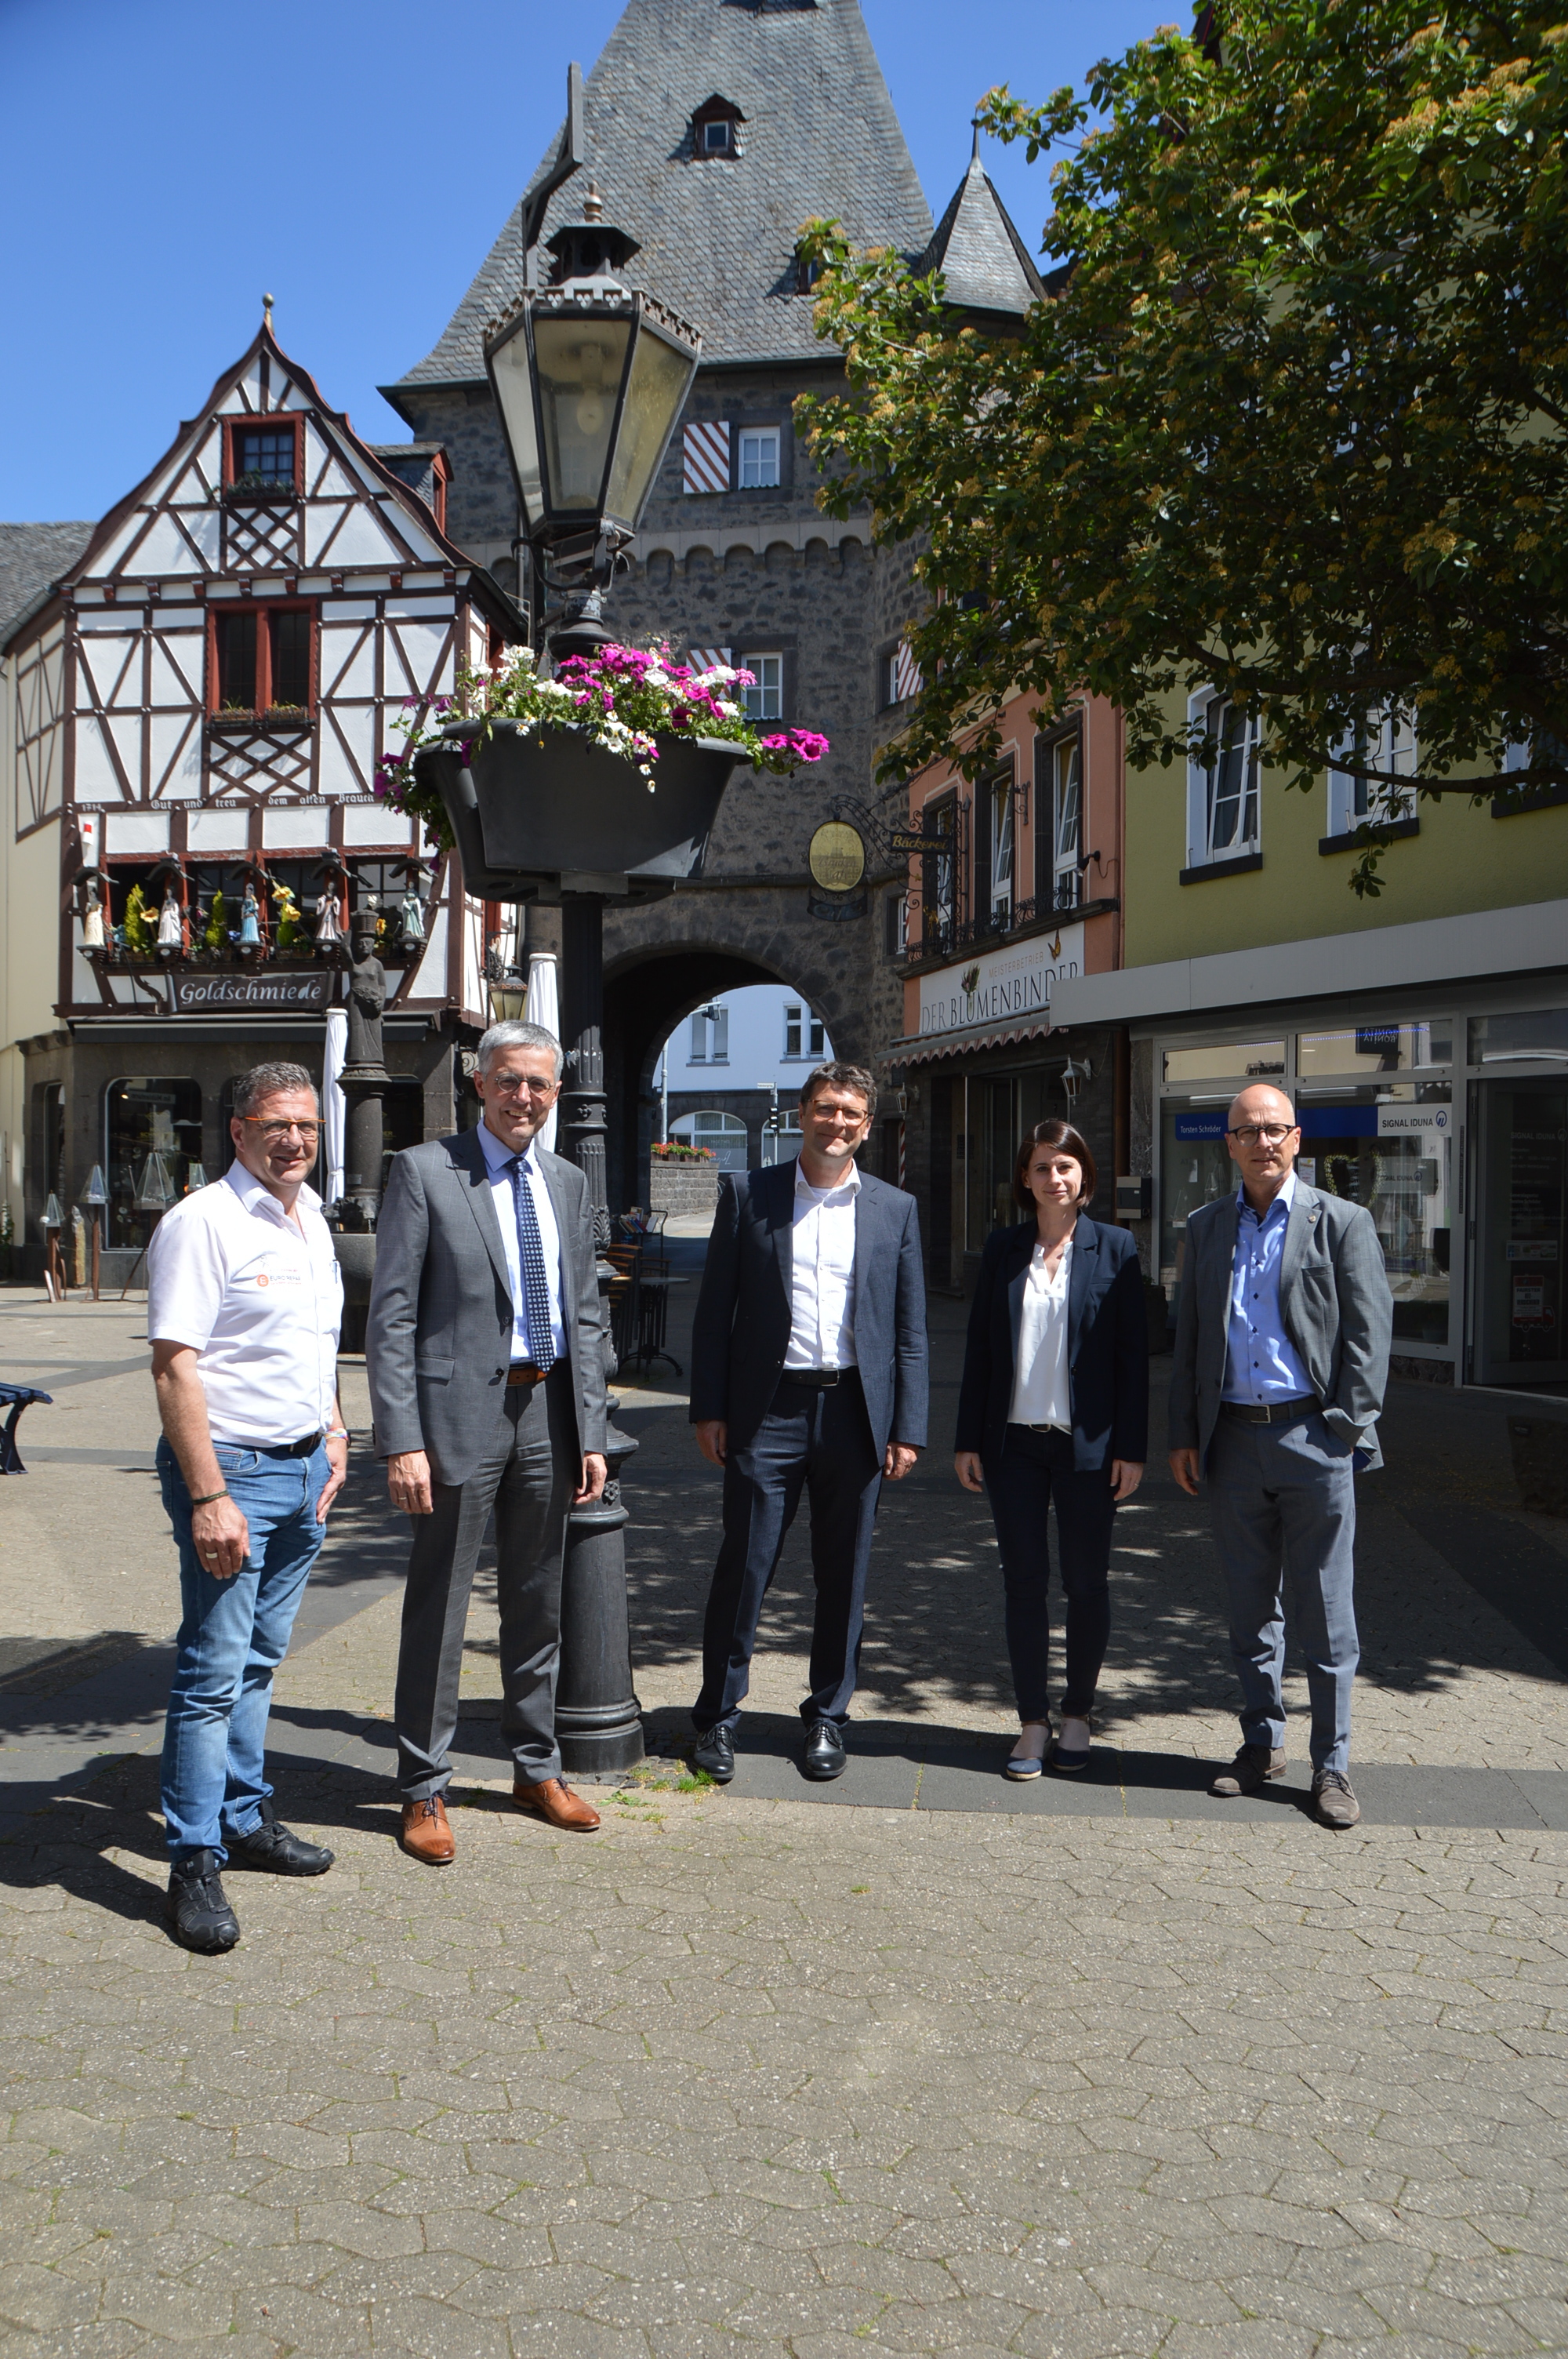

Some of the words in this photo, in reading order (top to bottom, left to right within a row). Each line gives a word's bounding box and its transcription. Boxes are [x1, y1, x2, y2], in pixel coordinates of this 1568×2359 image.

[151, 799, 172, 810] Gut
[183, 798, 202, 809] und
[215, 798, 236, 808] treu
[267, 795, 288, 805] dem
[892, 834, 949, 850] Bäckerei
[989, 951, 1044, 978] MEISTERBETRIEB
[180, 980, 321, 1005] Goldschmiede
[921, 1001, 946, 1034] DER
[1198, 1125, 1221, 1133] Schröder
[1382, 1119, 1409, 1128] SIGNAL
[1410, 1118, 1434, 1127] IDUNA
